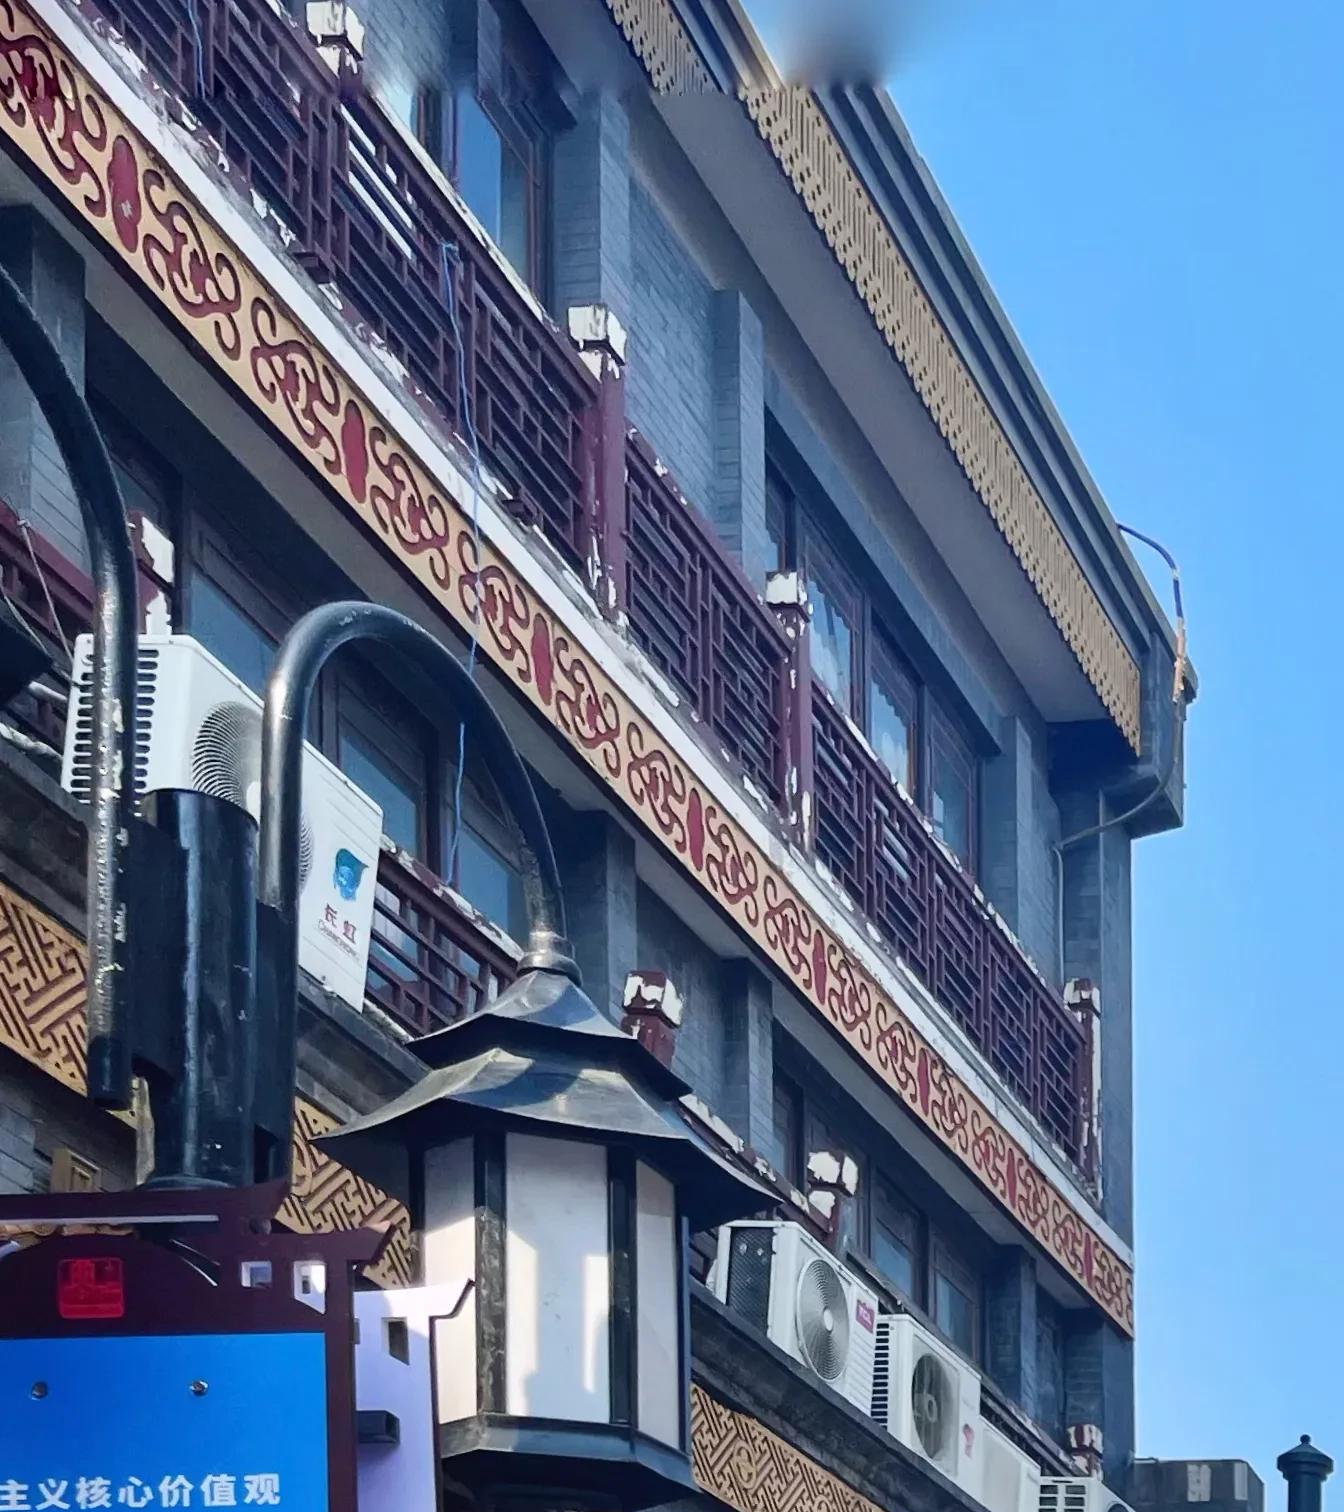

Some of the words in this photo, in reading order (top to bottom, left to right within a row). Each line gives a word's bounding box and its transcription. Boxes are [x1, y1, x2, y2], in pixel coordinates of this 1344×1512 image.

[0, 1473, 281, 1511] 主义核心价值观
